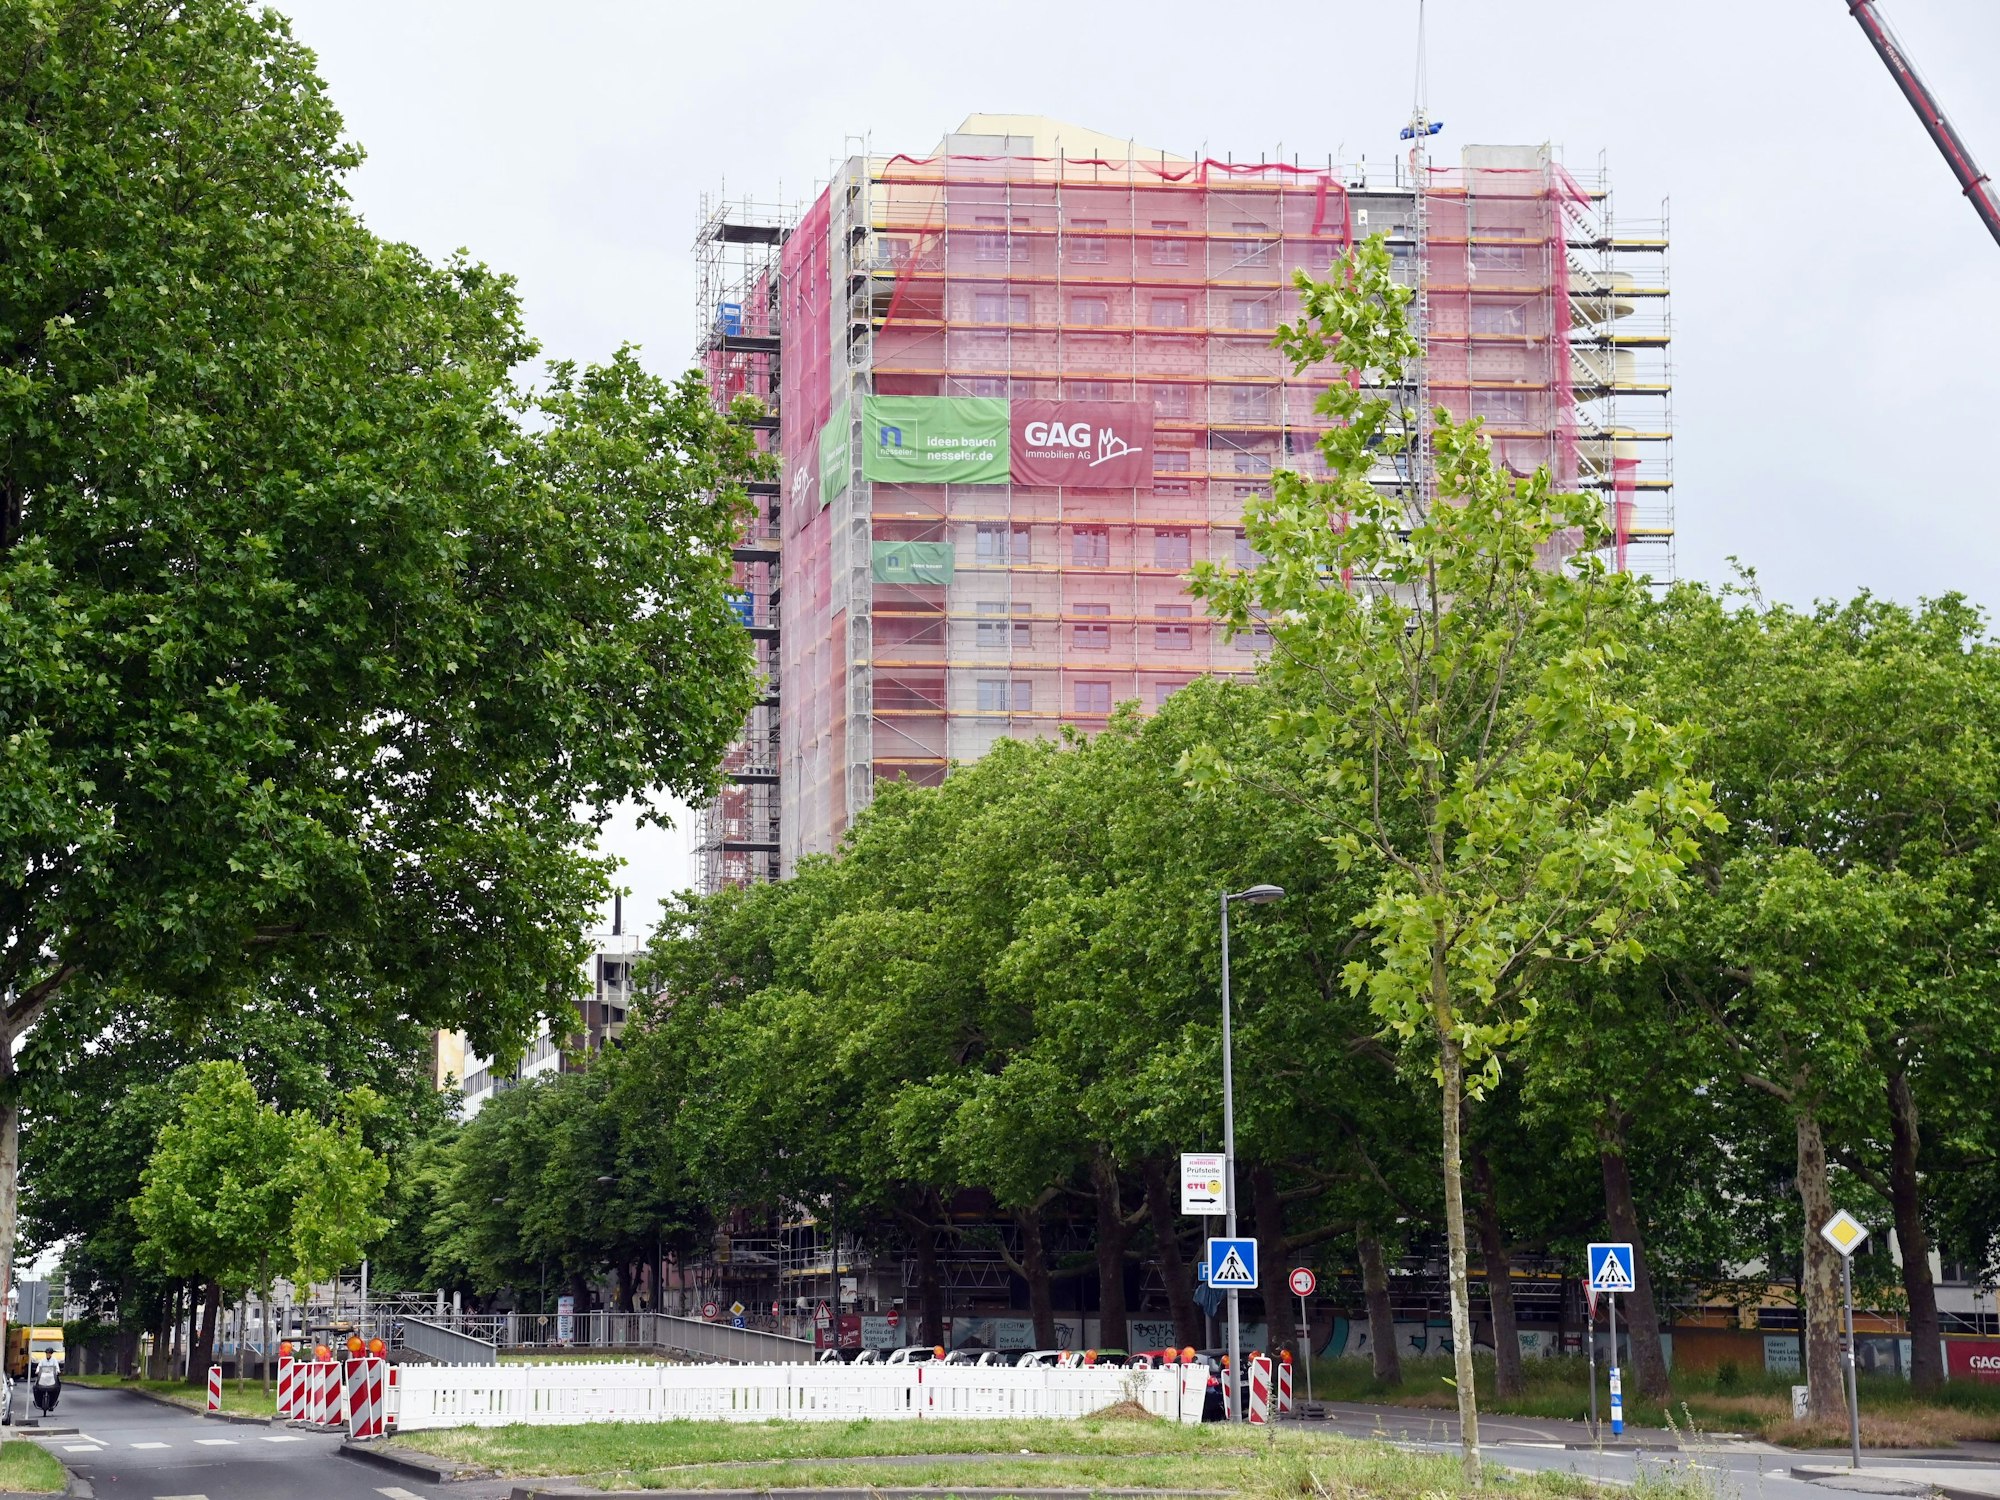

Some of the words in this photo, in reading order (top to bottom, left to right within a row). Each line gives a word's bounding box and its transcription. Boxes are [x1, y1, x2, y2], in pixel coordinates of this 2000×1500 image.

[880, 426, 902, 447] n
[1024, 421, 1091, 448] GAG
[927, 436, 959, 447] ideen
[961, 436, 997, 447] bauen
[880, 448, 913, 456] nesseler
[927, 450, 994, 461] nesseler.de
[1025, 449, 1075, 459] Immobilien
[1077, 451, 1091, 460] AG
[1149, 1336, 1176, 1347] SEC
[1969, 1355, 2000, 1369] GAG
